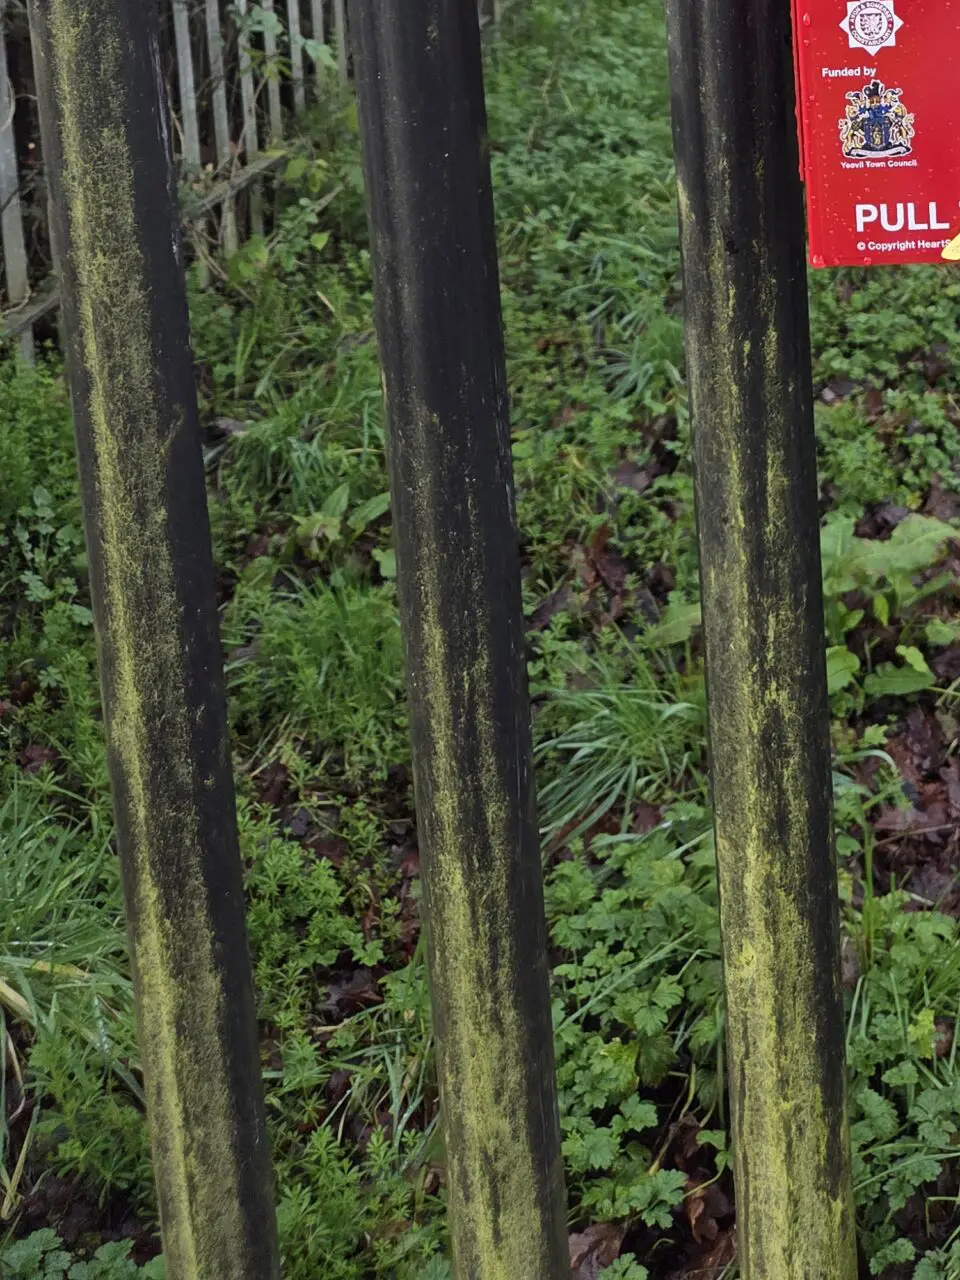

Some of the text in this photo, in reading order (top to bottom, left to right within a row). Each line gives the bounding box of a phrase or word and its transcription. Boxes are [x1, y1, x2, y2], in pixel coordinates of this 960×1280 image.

[821, 65, 877, 78] Funded by
[841, 159, 918, 169] Yeovil Town Council
[856, 202, 949, 232] PULL
[867, 240, 916, 252] Copyright
[918, 238, 960, 248] HeartS
